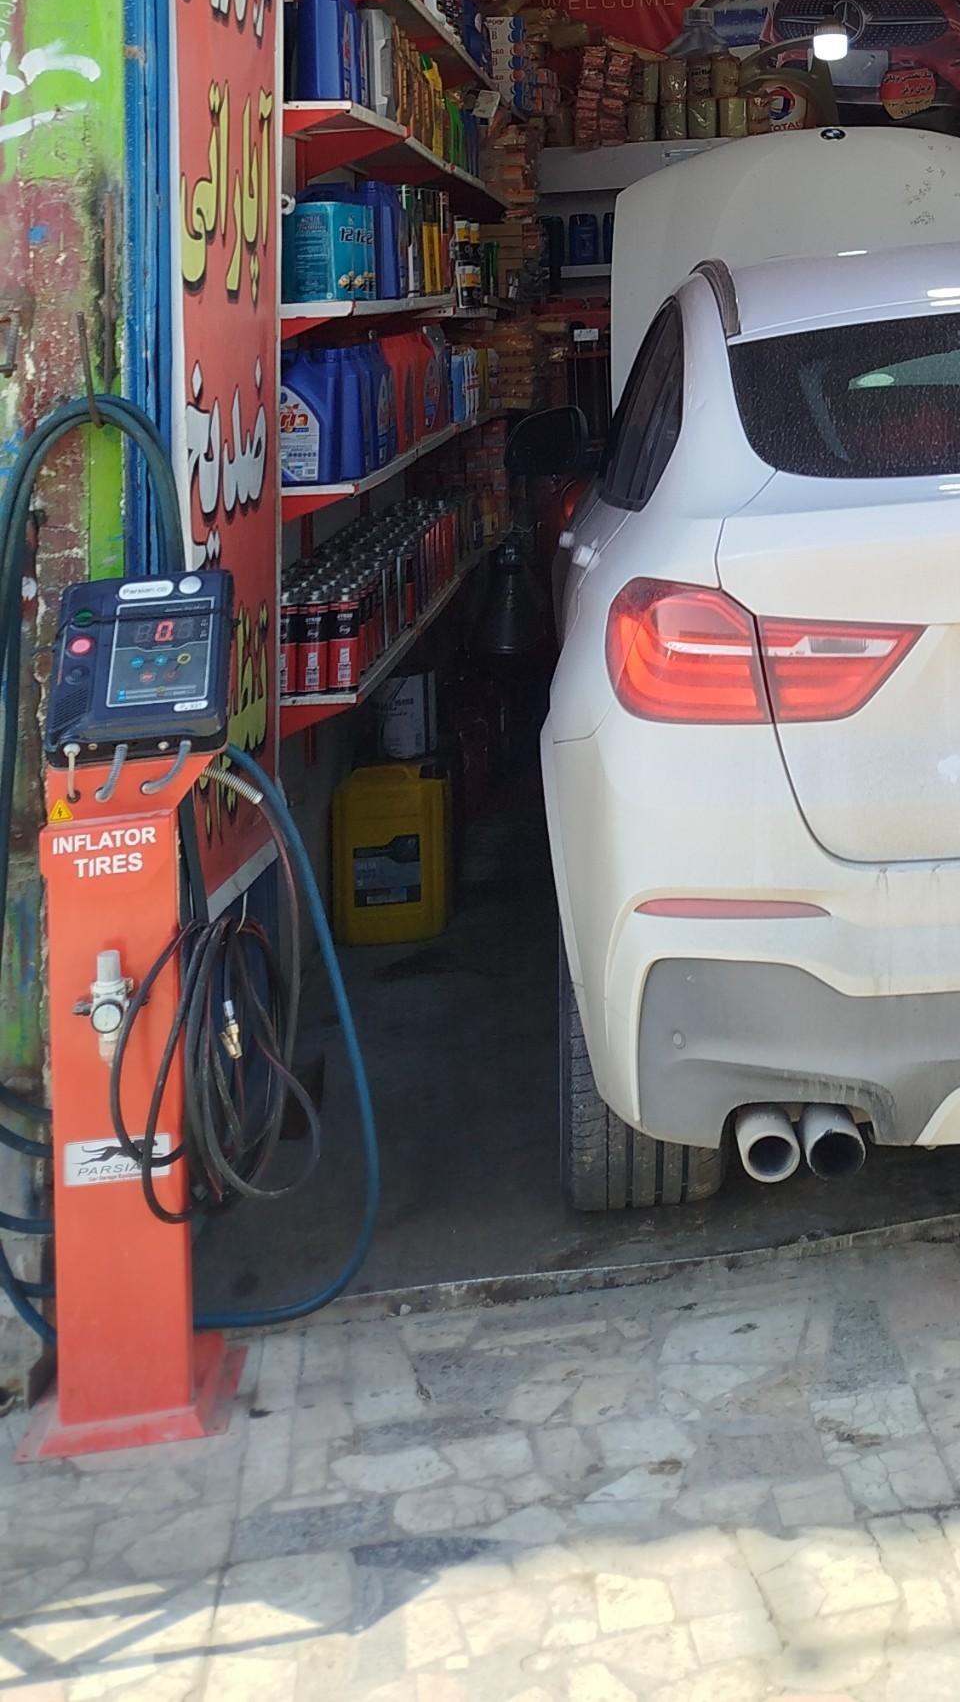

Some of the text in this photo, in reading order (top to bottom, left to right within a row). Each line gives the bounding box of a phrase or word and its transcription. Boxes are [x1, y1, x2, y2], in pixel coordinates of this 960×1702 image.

[179, 79, 274, 305] آپاراتی
[52, 825, 157, 855] INFLATOR
[73, 851, 144, 879] TIRES
[76, 1161, 143, 1178] PARSIA
